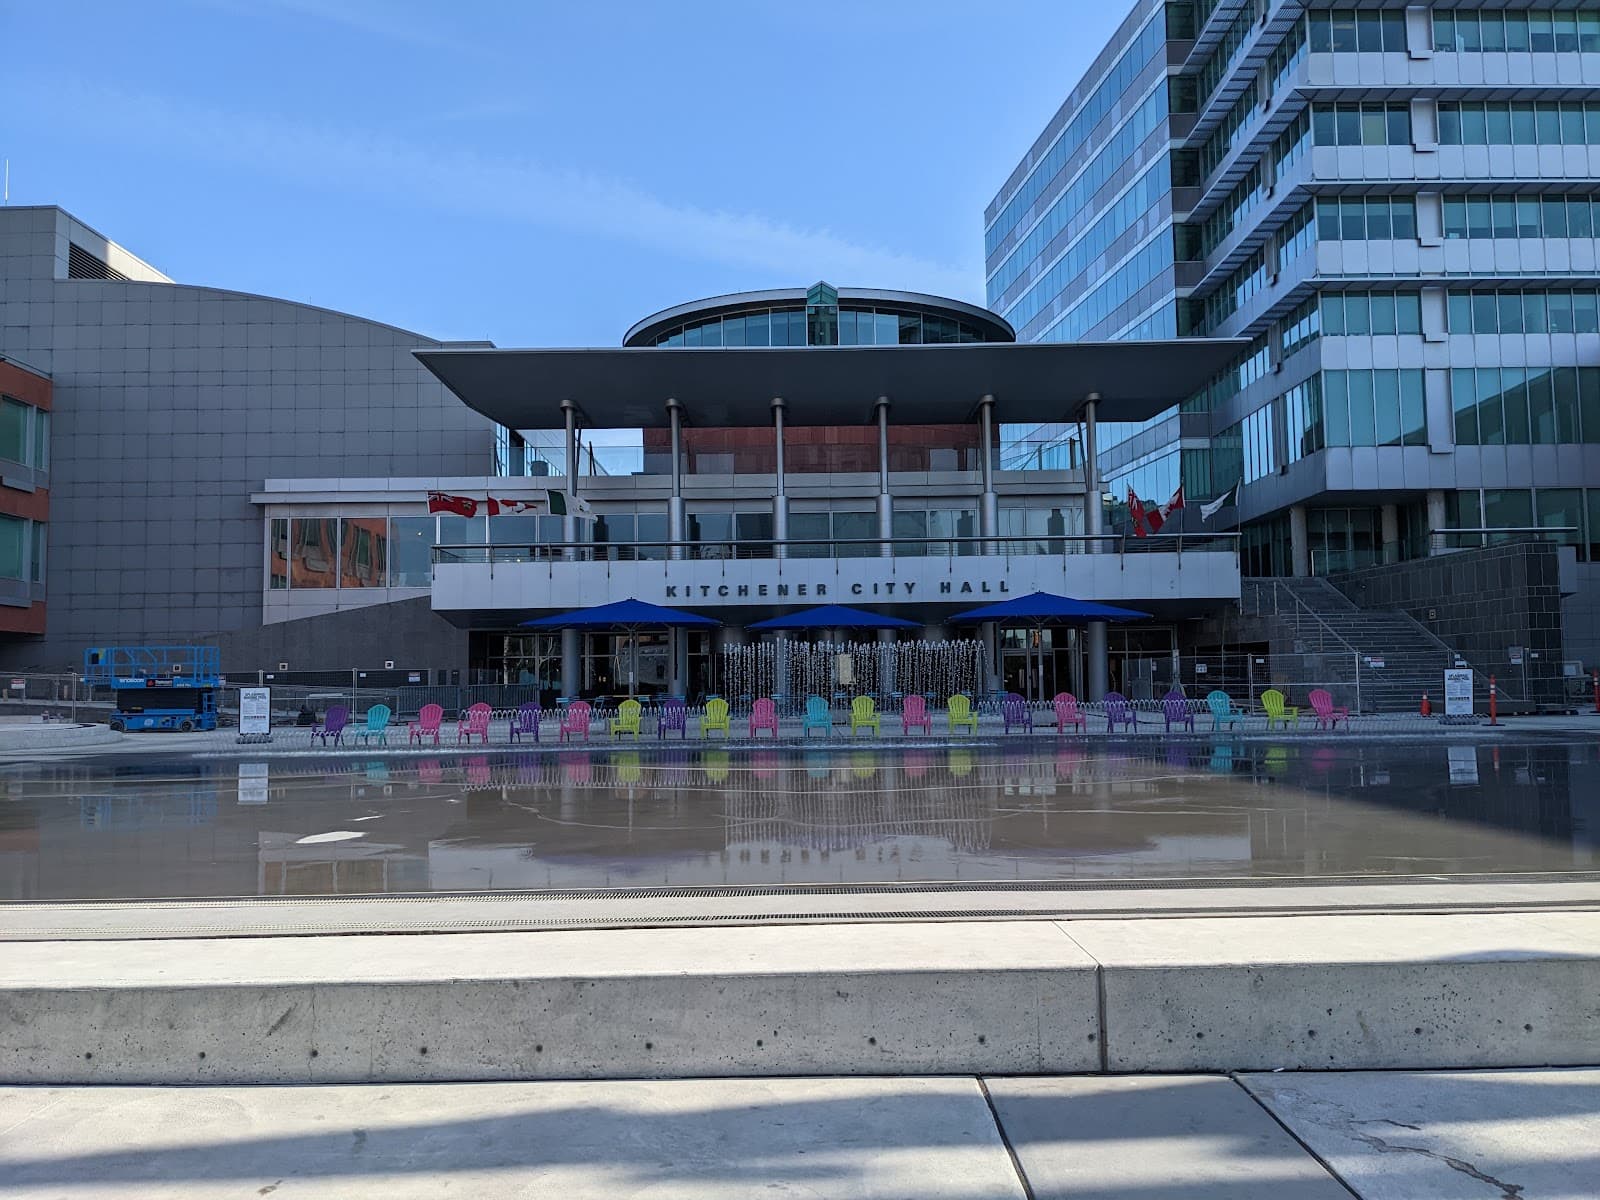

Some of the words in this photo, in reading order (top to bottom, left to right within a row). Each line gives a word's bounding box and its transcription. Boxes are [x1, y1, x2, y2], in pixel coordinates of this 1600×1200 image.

[666, 584, 827, 597] KITCHENER
[851, 582, 916, 595] CITY
[939, 581, 1009, 593] HALL
